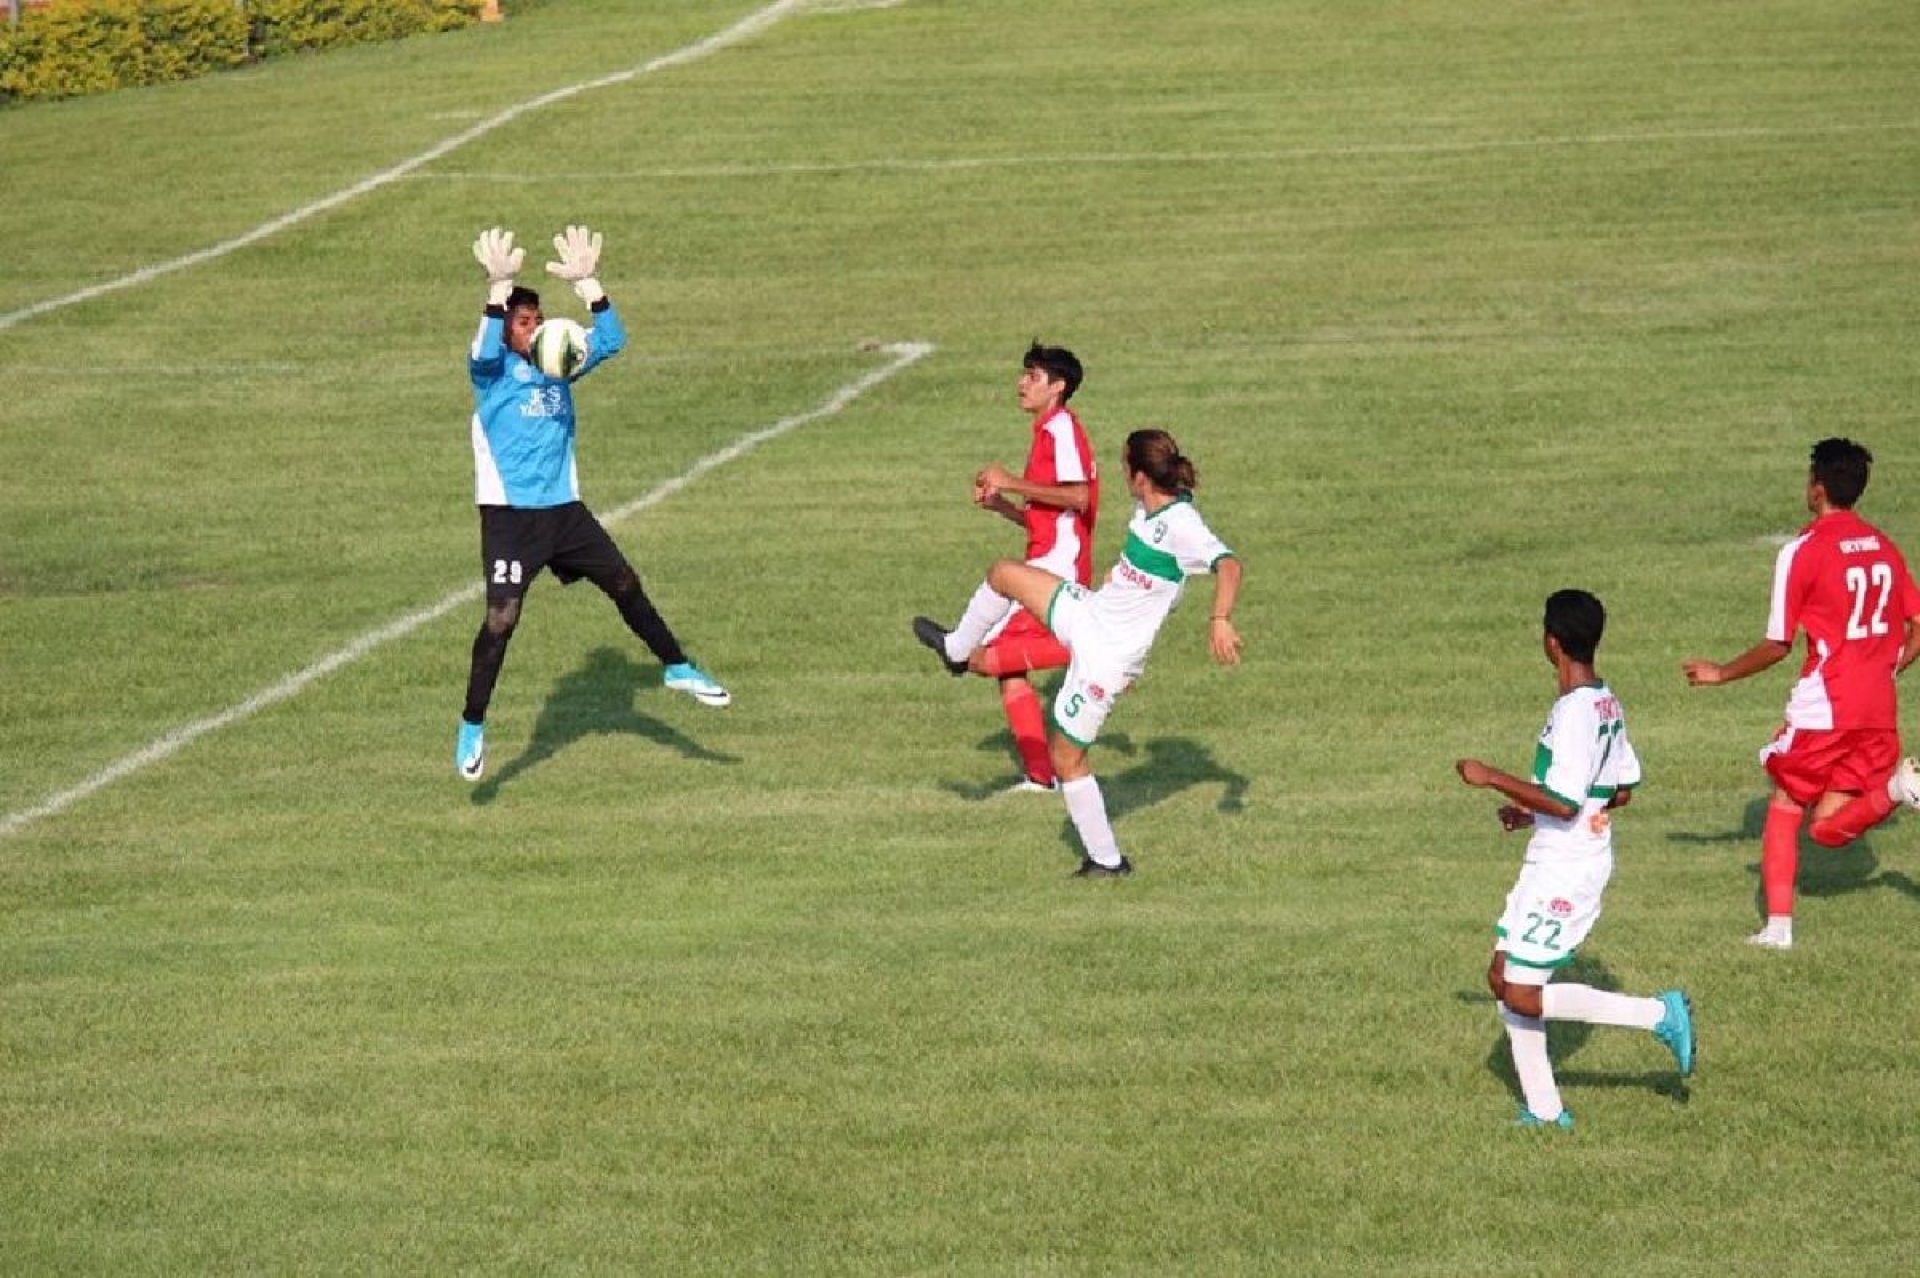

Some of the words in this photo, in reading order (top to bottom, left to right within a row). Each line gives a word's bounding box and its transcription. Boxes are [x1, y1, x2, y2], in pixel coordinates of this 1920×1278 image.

[493, 560, 522, 584] 29
[1846, 562, 1892, 640] 22
[1064, 693, 1086, 718] 5
[1522, 912, 1562, 950] 22
